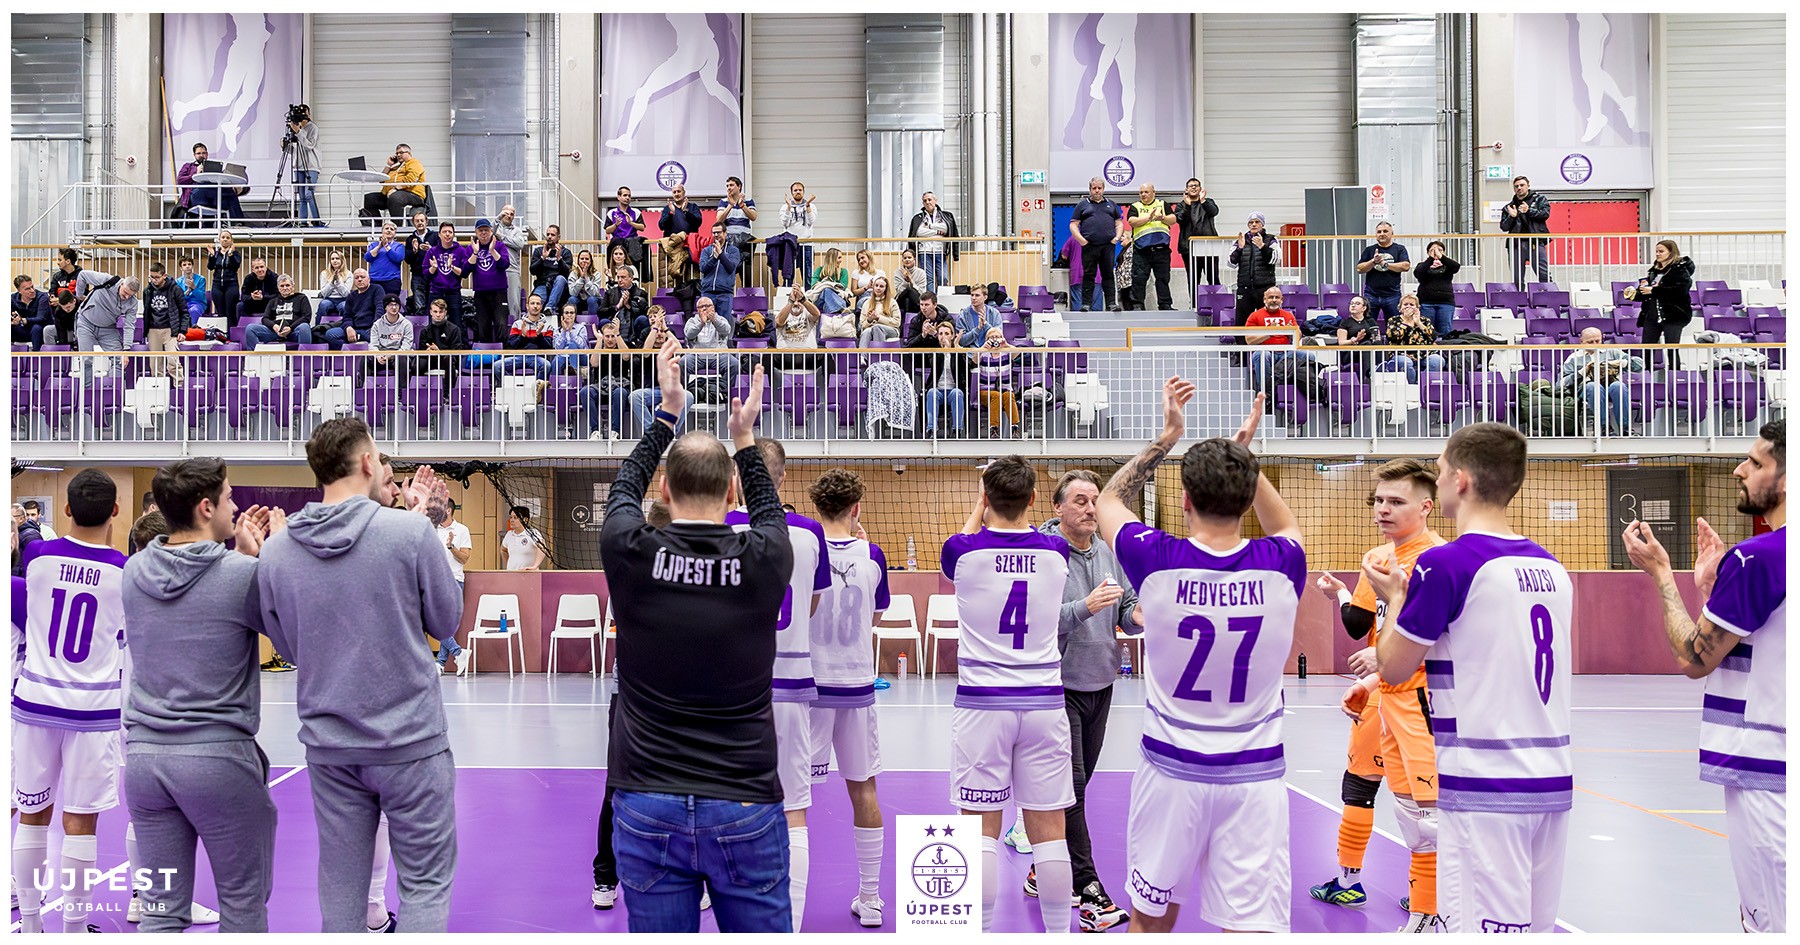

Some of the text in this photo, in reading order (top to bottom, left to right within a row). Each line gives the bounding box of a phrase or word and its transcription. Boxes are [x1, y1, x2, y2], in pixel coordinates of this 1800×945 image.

[1619, 493, 1638, 525] 3
[59, 563, 101, 587] THIAGO
[652, 546, 741, 587] ÚJPEST FC
[995, 554, 1037, 574] SZENTE
[1514, 567, 1556, 592] HADZSI
[1176, 579, 1264, 607] MEDVECZKI
[48, 587, 99, 663] 10
[998, 580, 1029, 650] 4
[1172, 614, 1264, 703] 27
[1530, 603, 1555, 706] 8
